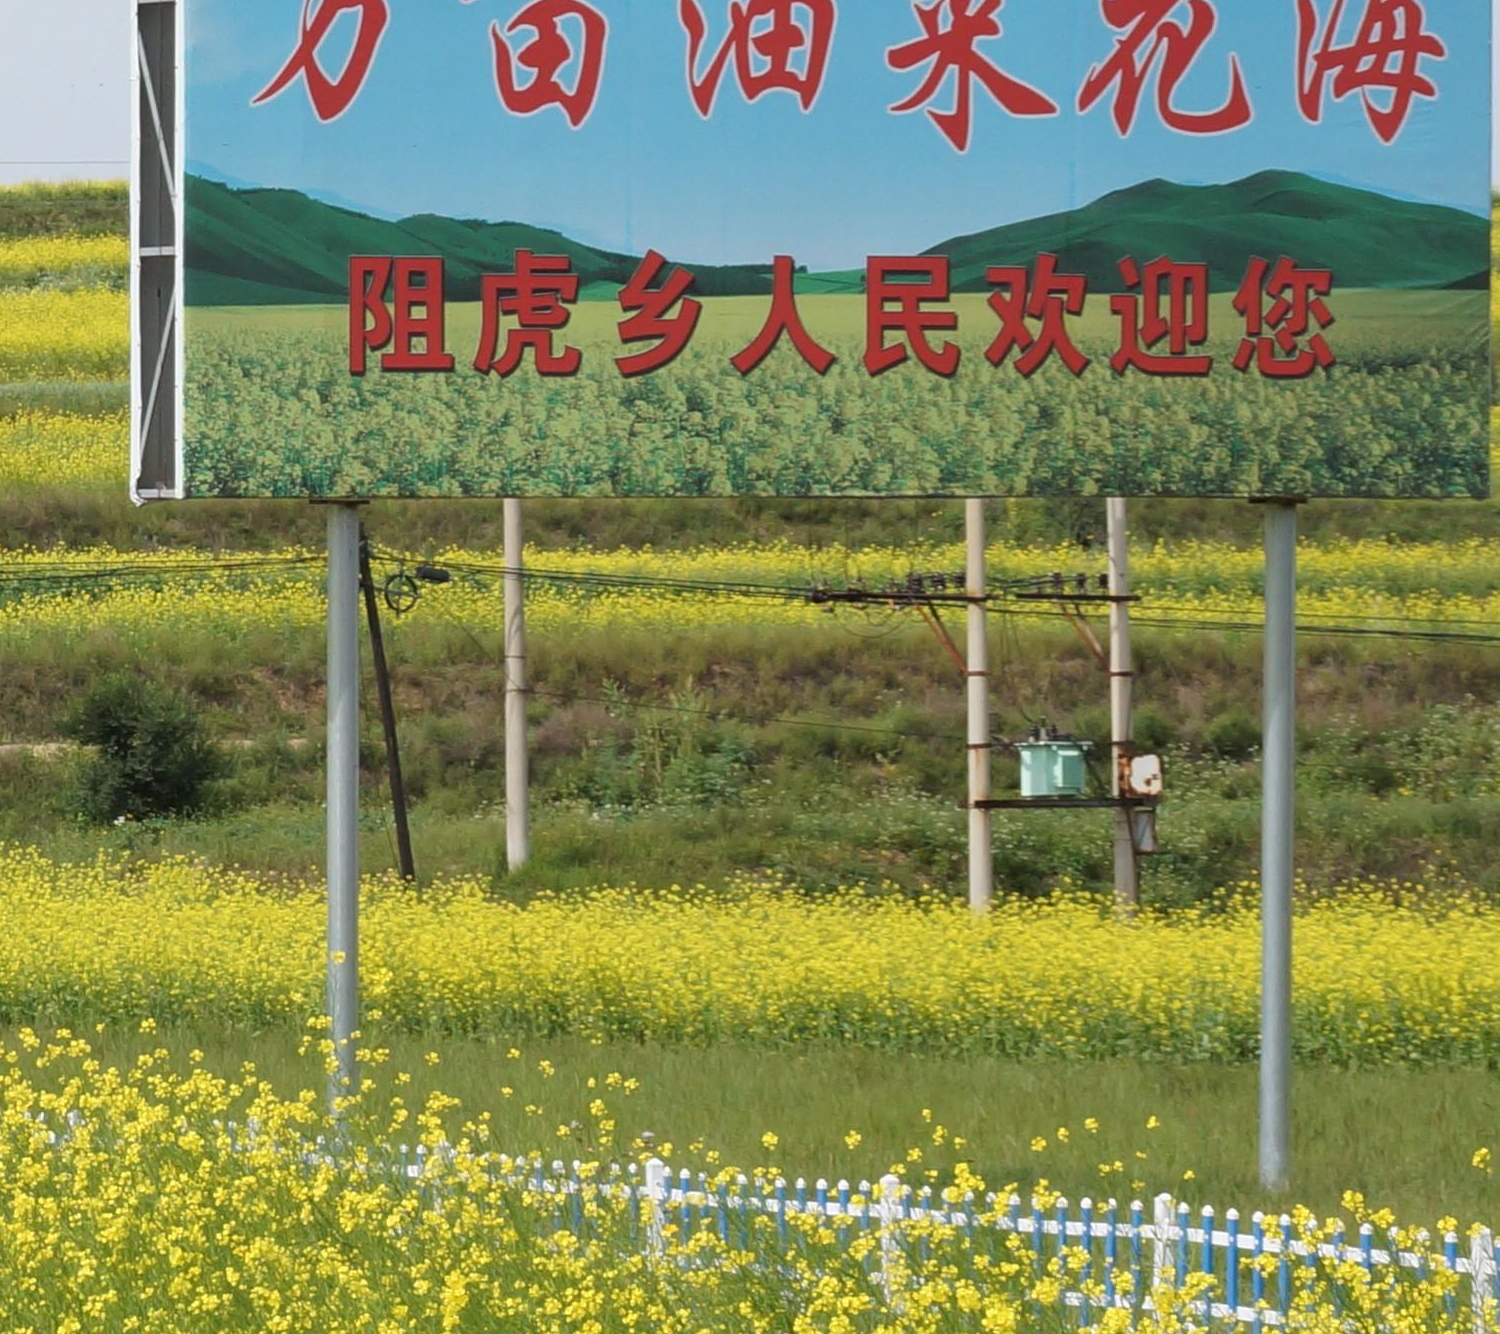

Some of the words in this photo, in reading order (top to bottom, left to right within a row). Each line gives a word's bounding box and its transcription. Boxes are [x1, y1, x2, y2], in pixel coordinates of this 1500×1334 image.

[349, 248, 1336, 378] 阻虎乡人民欢迎您
